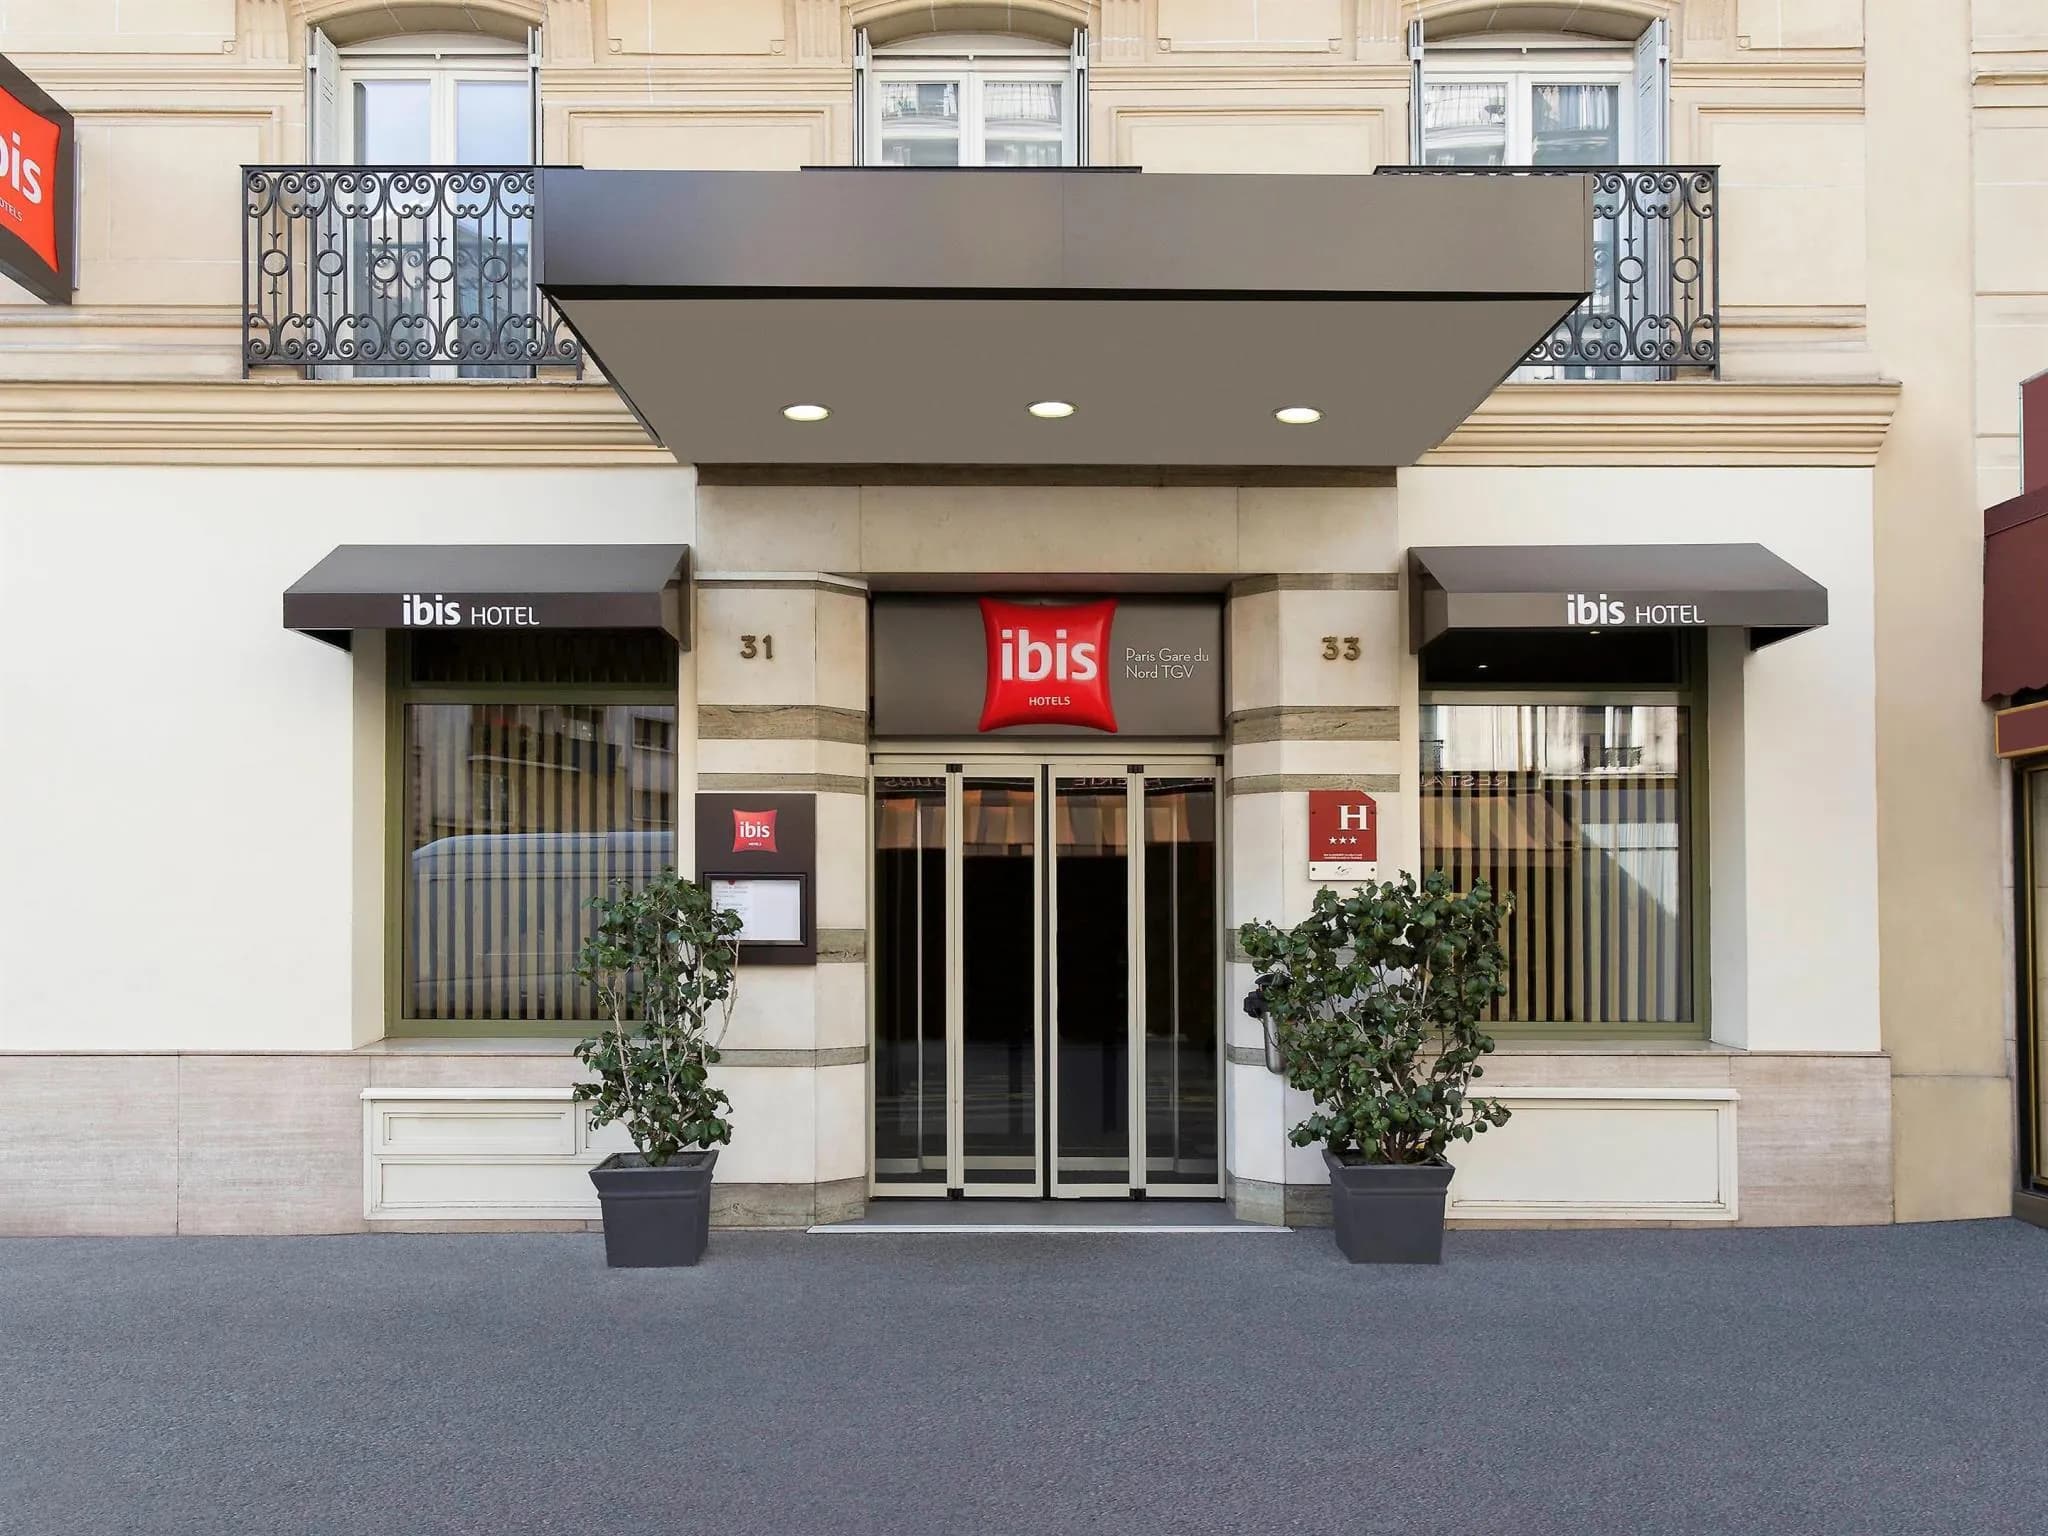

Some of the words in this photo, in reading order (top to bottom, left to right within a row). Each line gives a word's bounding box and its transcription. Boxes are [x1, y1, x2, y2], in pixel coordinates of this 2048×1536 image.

[403, 594, 461, 625] ibis
[471, 606, 540, 625] HOTEL
[1567, 593, 1626, 625] ibis
[1635, 605, 1706, 624] HOTEL
[740, 635, 773, 659] 31
[1002, 629, 1098, 682] ibis
[1126, 647, 1156, 662] Paris
[1159, 647, 1191, 662] Gare
[1193, 647, 1209, 662] du
[1322, 636, 1361, 661] 33
[1126, 664, 1158, 679] Nord
[1161, 664, 1194, 679] TGV
[1029, 696, 1071, 706] HOTELS
[740, 821, 770, 838] ibis
[1338, 805, 1369, 830] H
